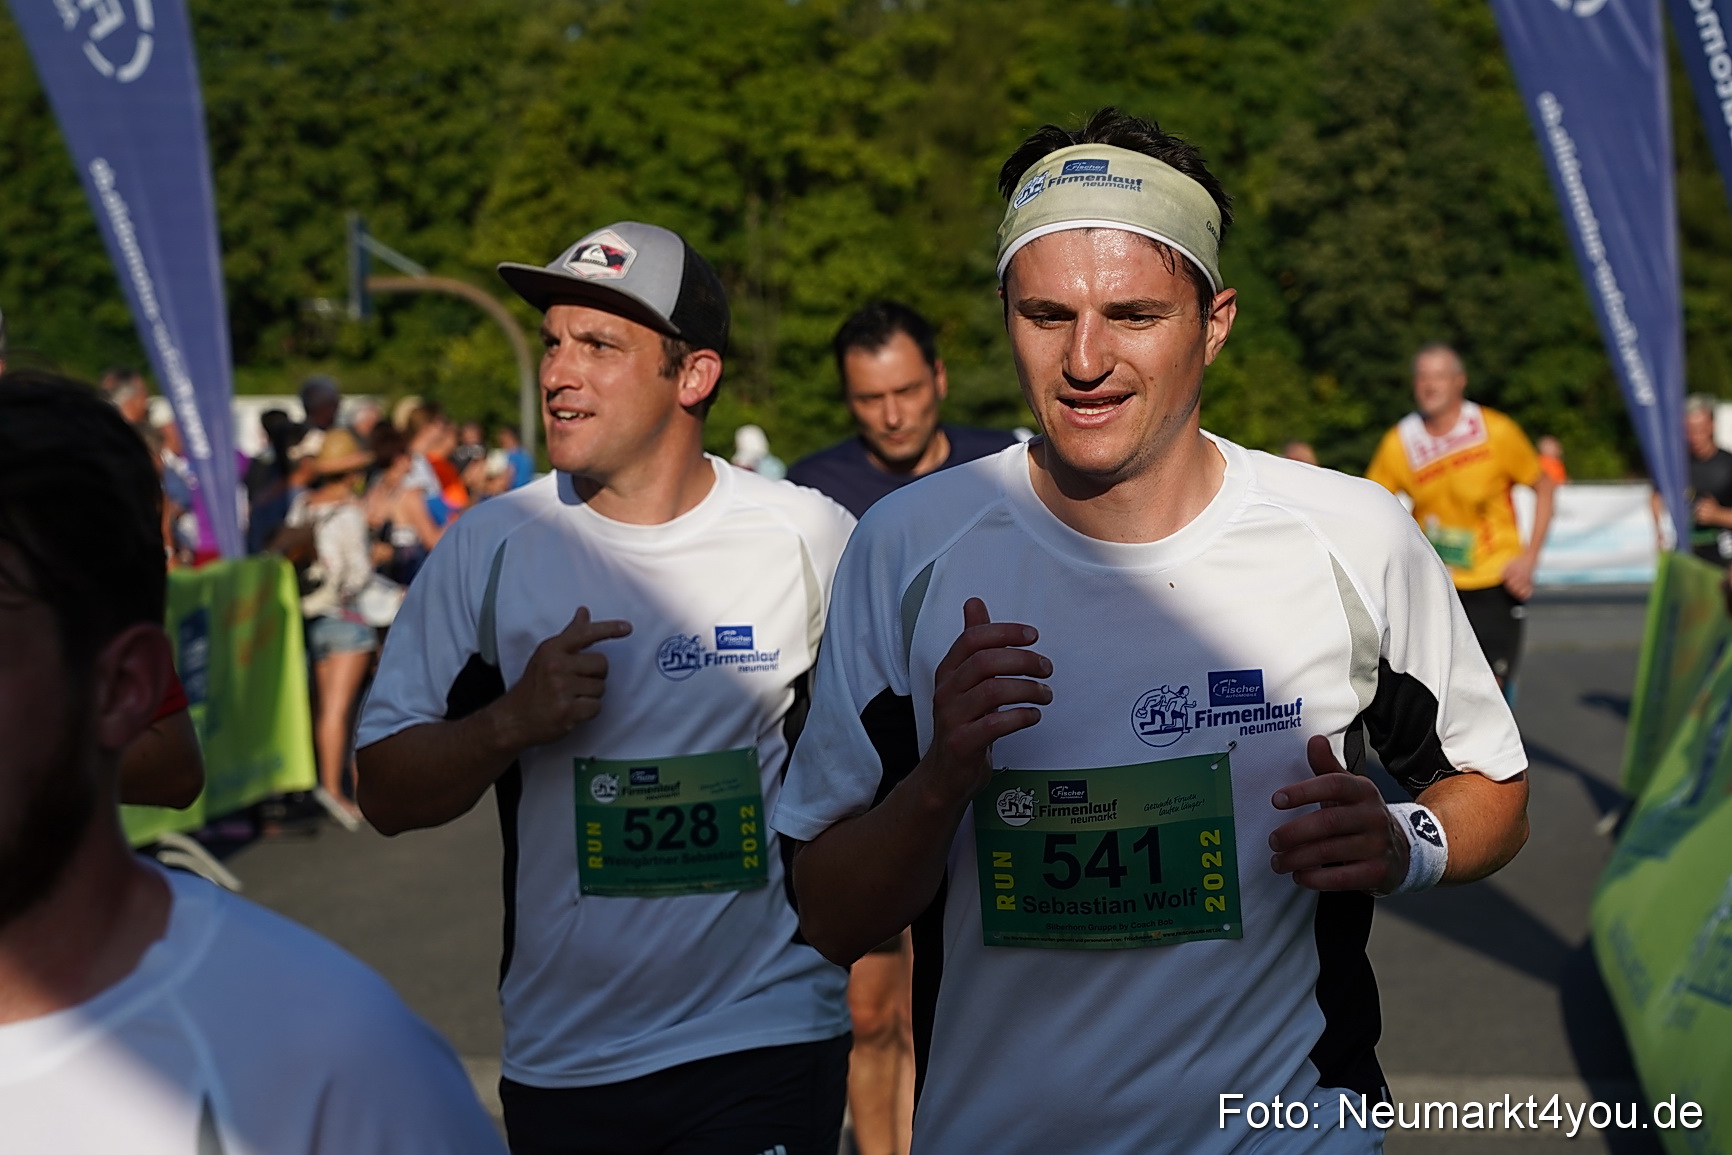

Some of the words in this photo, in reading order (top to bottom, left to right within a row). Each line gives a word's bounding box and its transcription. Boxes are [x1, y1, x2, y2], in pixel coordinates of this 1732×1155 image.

[1047, 174, 1143, 188] Firmenlauf
[1082, 180, 1142, 192] neumarkt
[705, 649, 780, 666] Firmenlauf
[1221, 684, 1260, 695] Fischer
[1195, 697, 1303, 729] Firmenlauf
[1239, 716, 1303, 737] neumarkt
[621, 781, 681, 796] Firmenlauf
[1057, 789, 1086, 797] Fischer
[1039, 799, 1118, 817] Firmenlauf
[624, 802, 719, 851] 528
[1070, 811, 1118, 825] neumarkt
[586, 821, 604, 870] RUN
[739, 804, 760, 870] 2022
[682, 850, 741, 865] Sebastian
[1042, 826, 1162, 890] 541
[1199, 828, 1227, 913] 2022
[992, 851, 1017, 911] RUN
[1022, 895, 1137, 915] Sebastian
[1143, 887, 1198, 911] Wolf
[1046, 922, 1086, 931] Silberhorn
[1088, 923, 1117, 931] Gruppe
[1119, 922, 1129, 930] by
[1130, 920, 1156, 929] Coach
[1157, 918, 1174, 926] Bob
